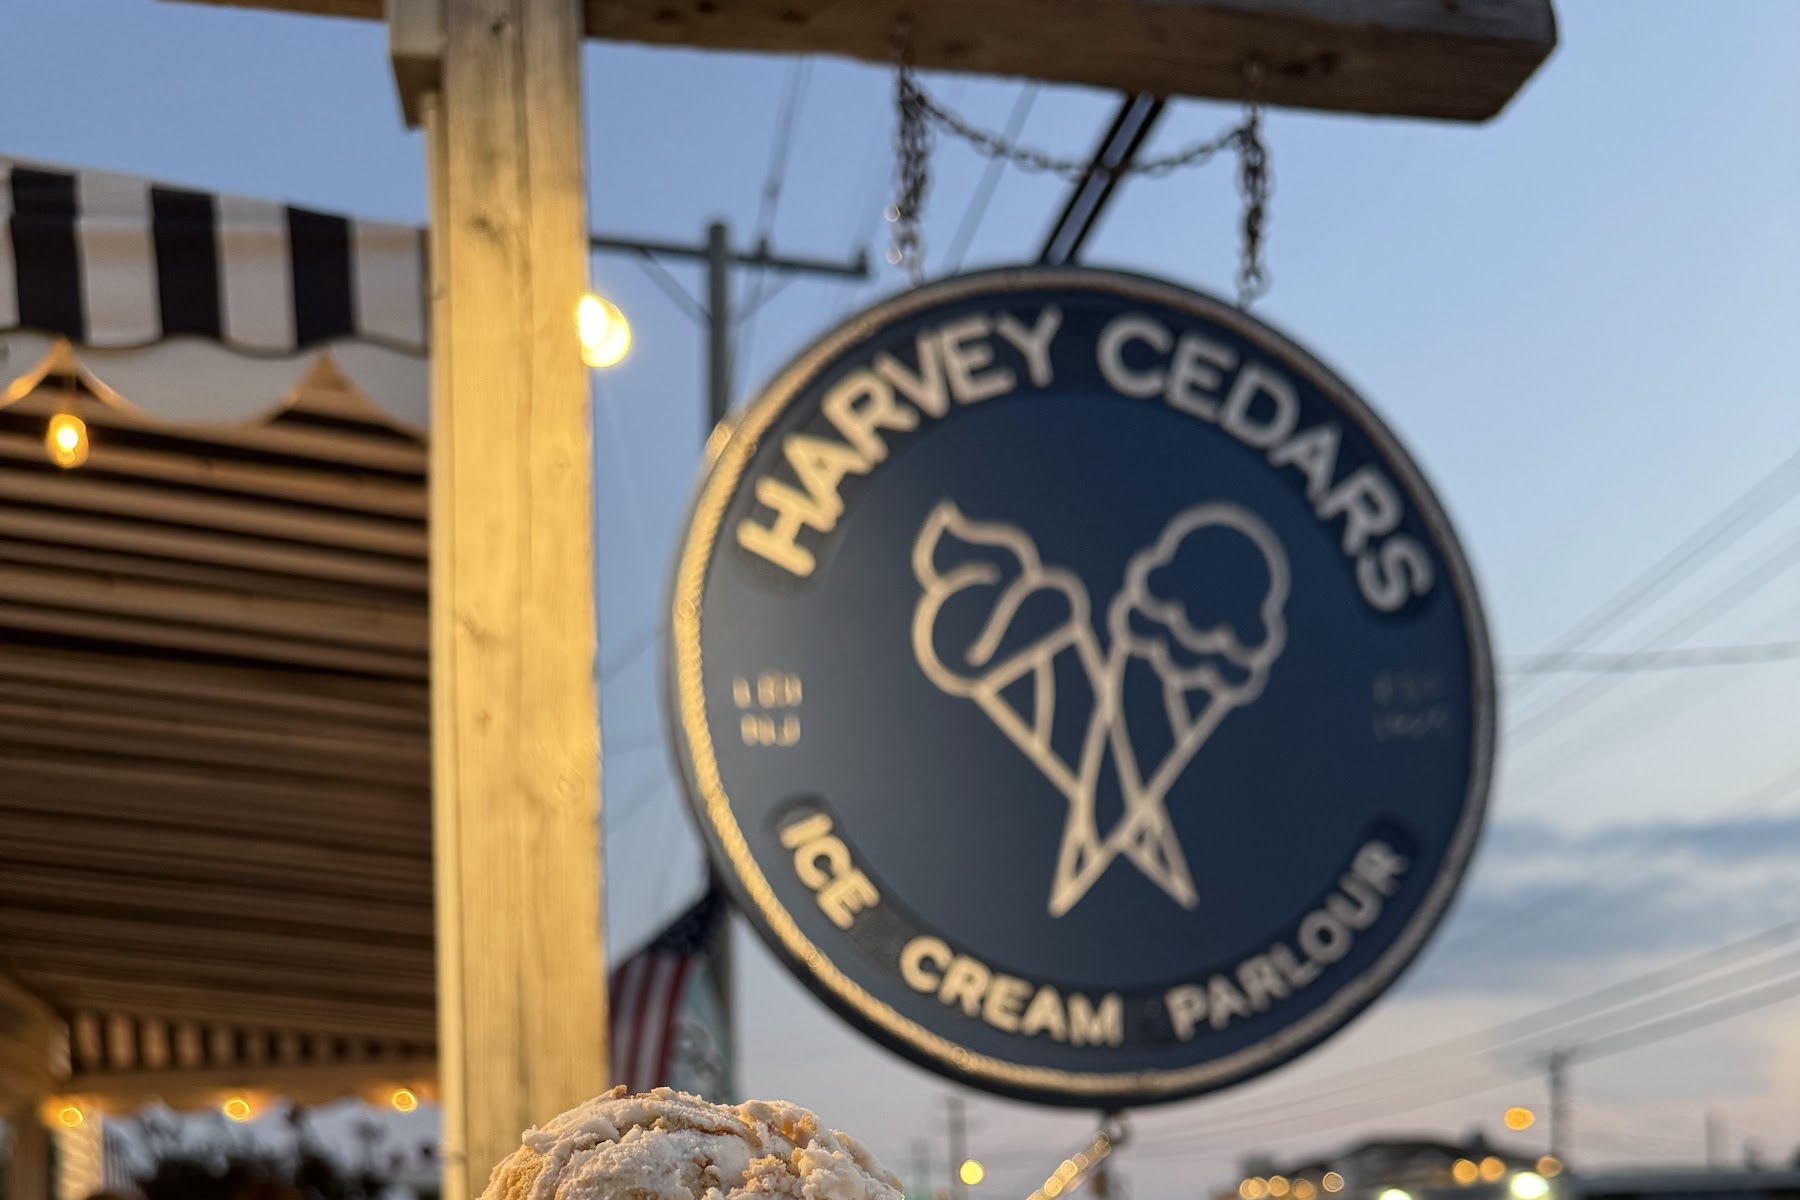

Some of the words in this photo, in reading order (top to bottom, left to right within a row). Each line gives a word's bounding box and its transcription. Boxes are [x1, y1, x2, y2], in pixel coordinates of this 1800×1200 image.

[739, 306, 1063, 578] HARVEY
[1097, 315, 1434, 613] CEDARS
[780, 813, 881, 930] ICE
[899, 935, 1124, 1047] CREAM
[1167, 839, 1408, 1042] PARLOUR
